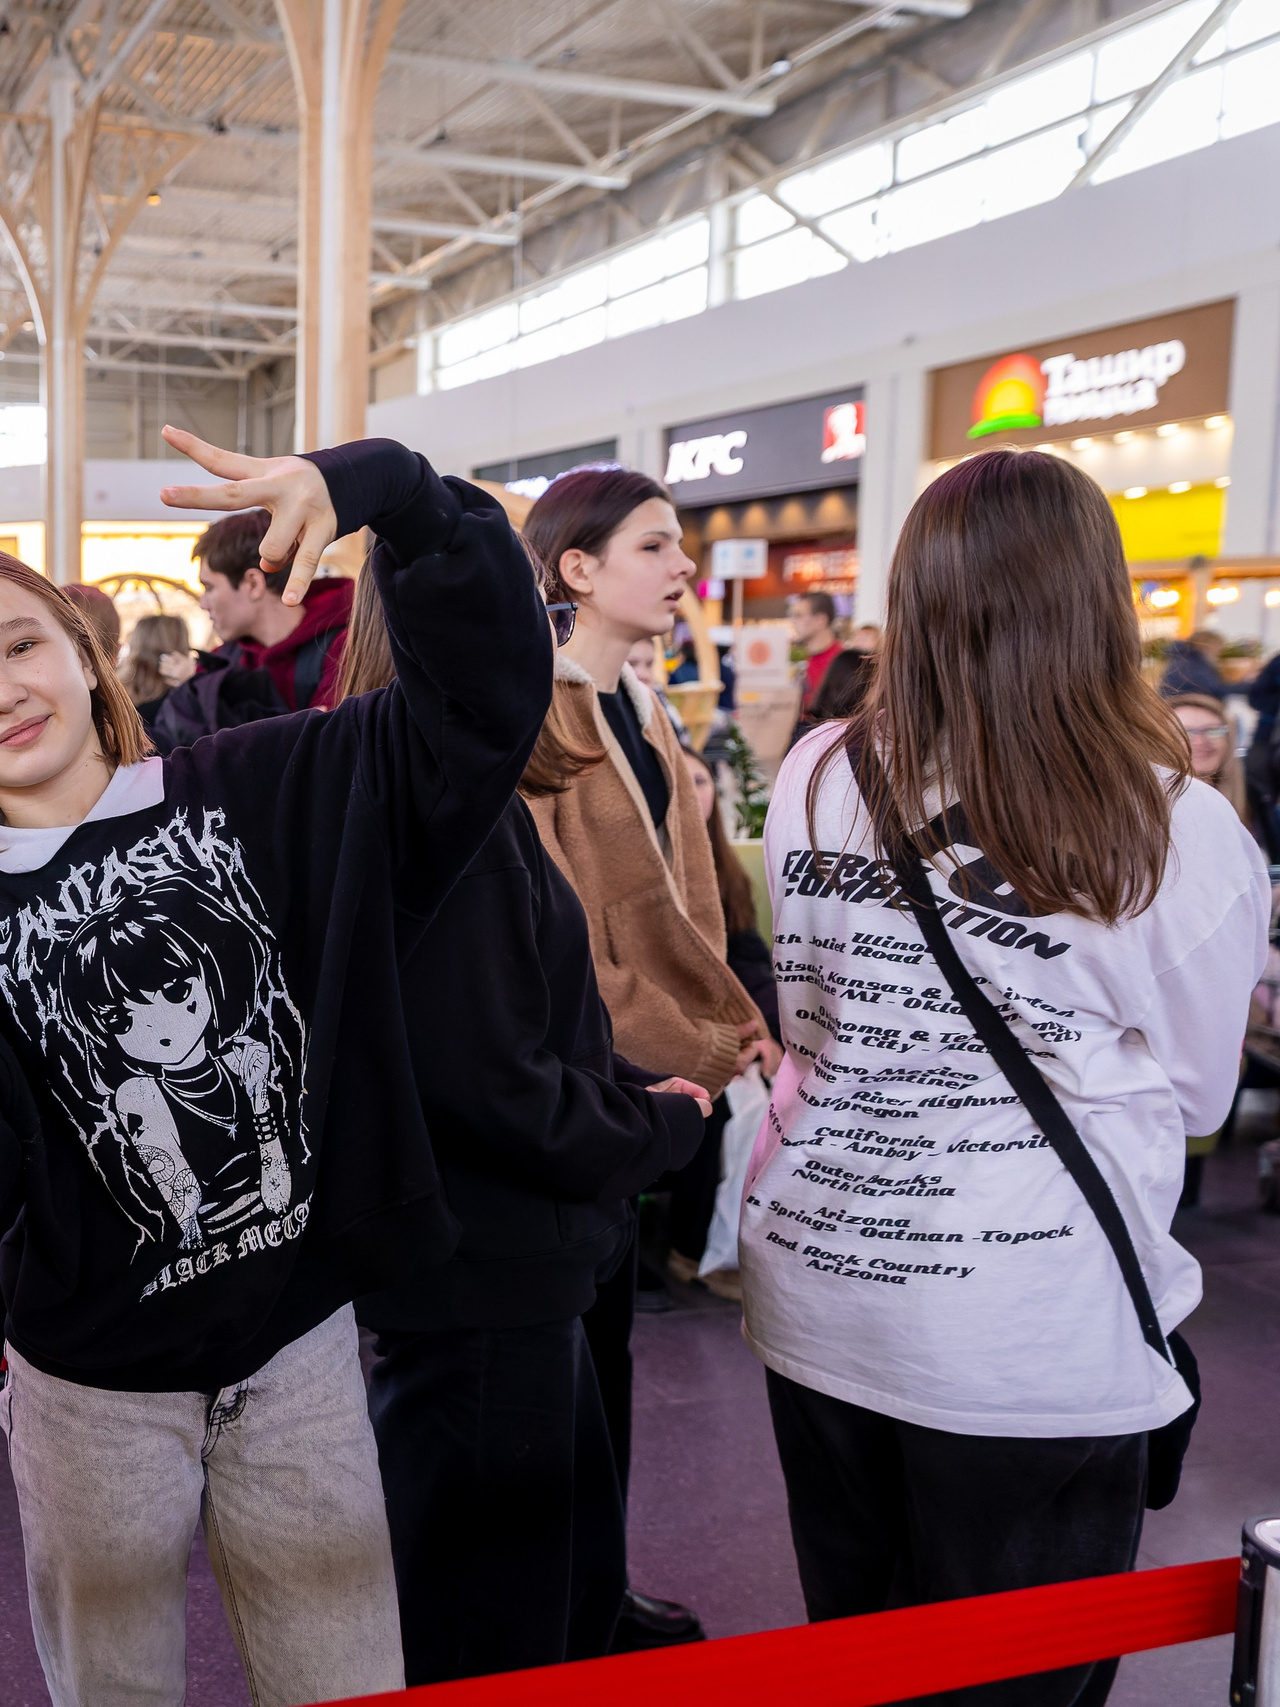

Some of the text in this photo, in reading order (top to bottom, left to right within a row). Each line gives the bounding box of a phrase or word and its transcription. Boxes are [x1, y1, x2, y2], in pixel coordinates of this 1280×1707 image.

[664, 430, 747, 484] KFC
[782, 850, 934, 882] FIERC
[809, 935, 846, 953] Joliet
[851, 945, 924, 965] Road
[851, 932, 933, 953] Illino
[827, 971, 913, 995] Kansas
[920, 988, 942, 1000] &
[839, 989, 882, 1004] MI
[861, 1035, 916, 1053] City
[909, 1030, 931, 1042] &
[818, 1052, 869, 1075] Nuevo
[876, 1066, 979, 1081] Mexico
[834, 1101, 920, 1119] Oregon
[851, 1091, 913, 1107] River
[815, 1126, 937, 1149] California
[843, 1142, 923, 1161] Amboy
[947, 1134, 1053, 1153] Victorvil
[791, 1169, 957, 1197] North Carolina
[805, 1160, 864, 1183] Outer
[237, 1189, 314, 1259] META
[768, 1200, 838, 1232] Springs
[859, 1227, 964, 1243] Oatman
[813, 1206, 911, 1228] Arizona
[766, 1231, 976, 1278] Red Rock Country
[806, 1259, 907, 1285] Arizona
